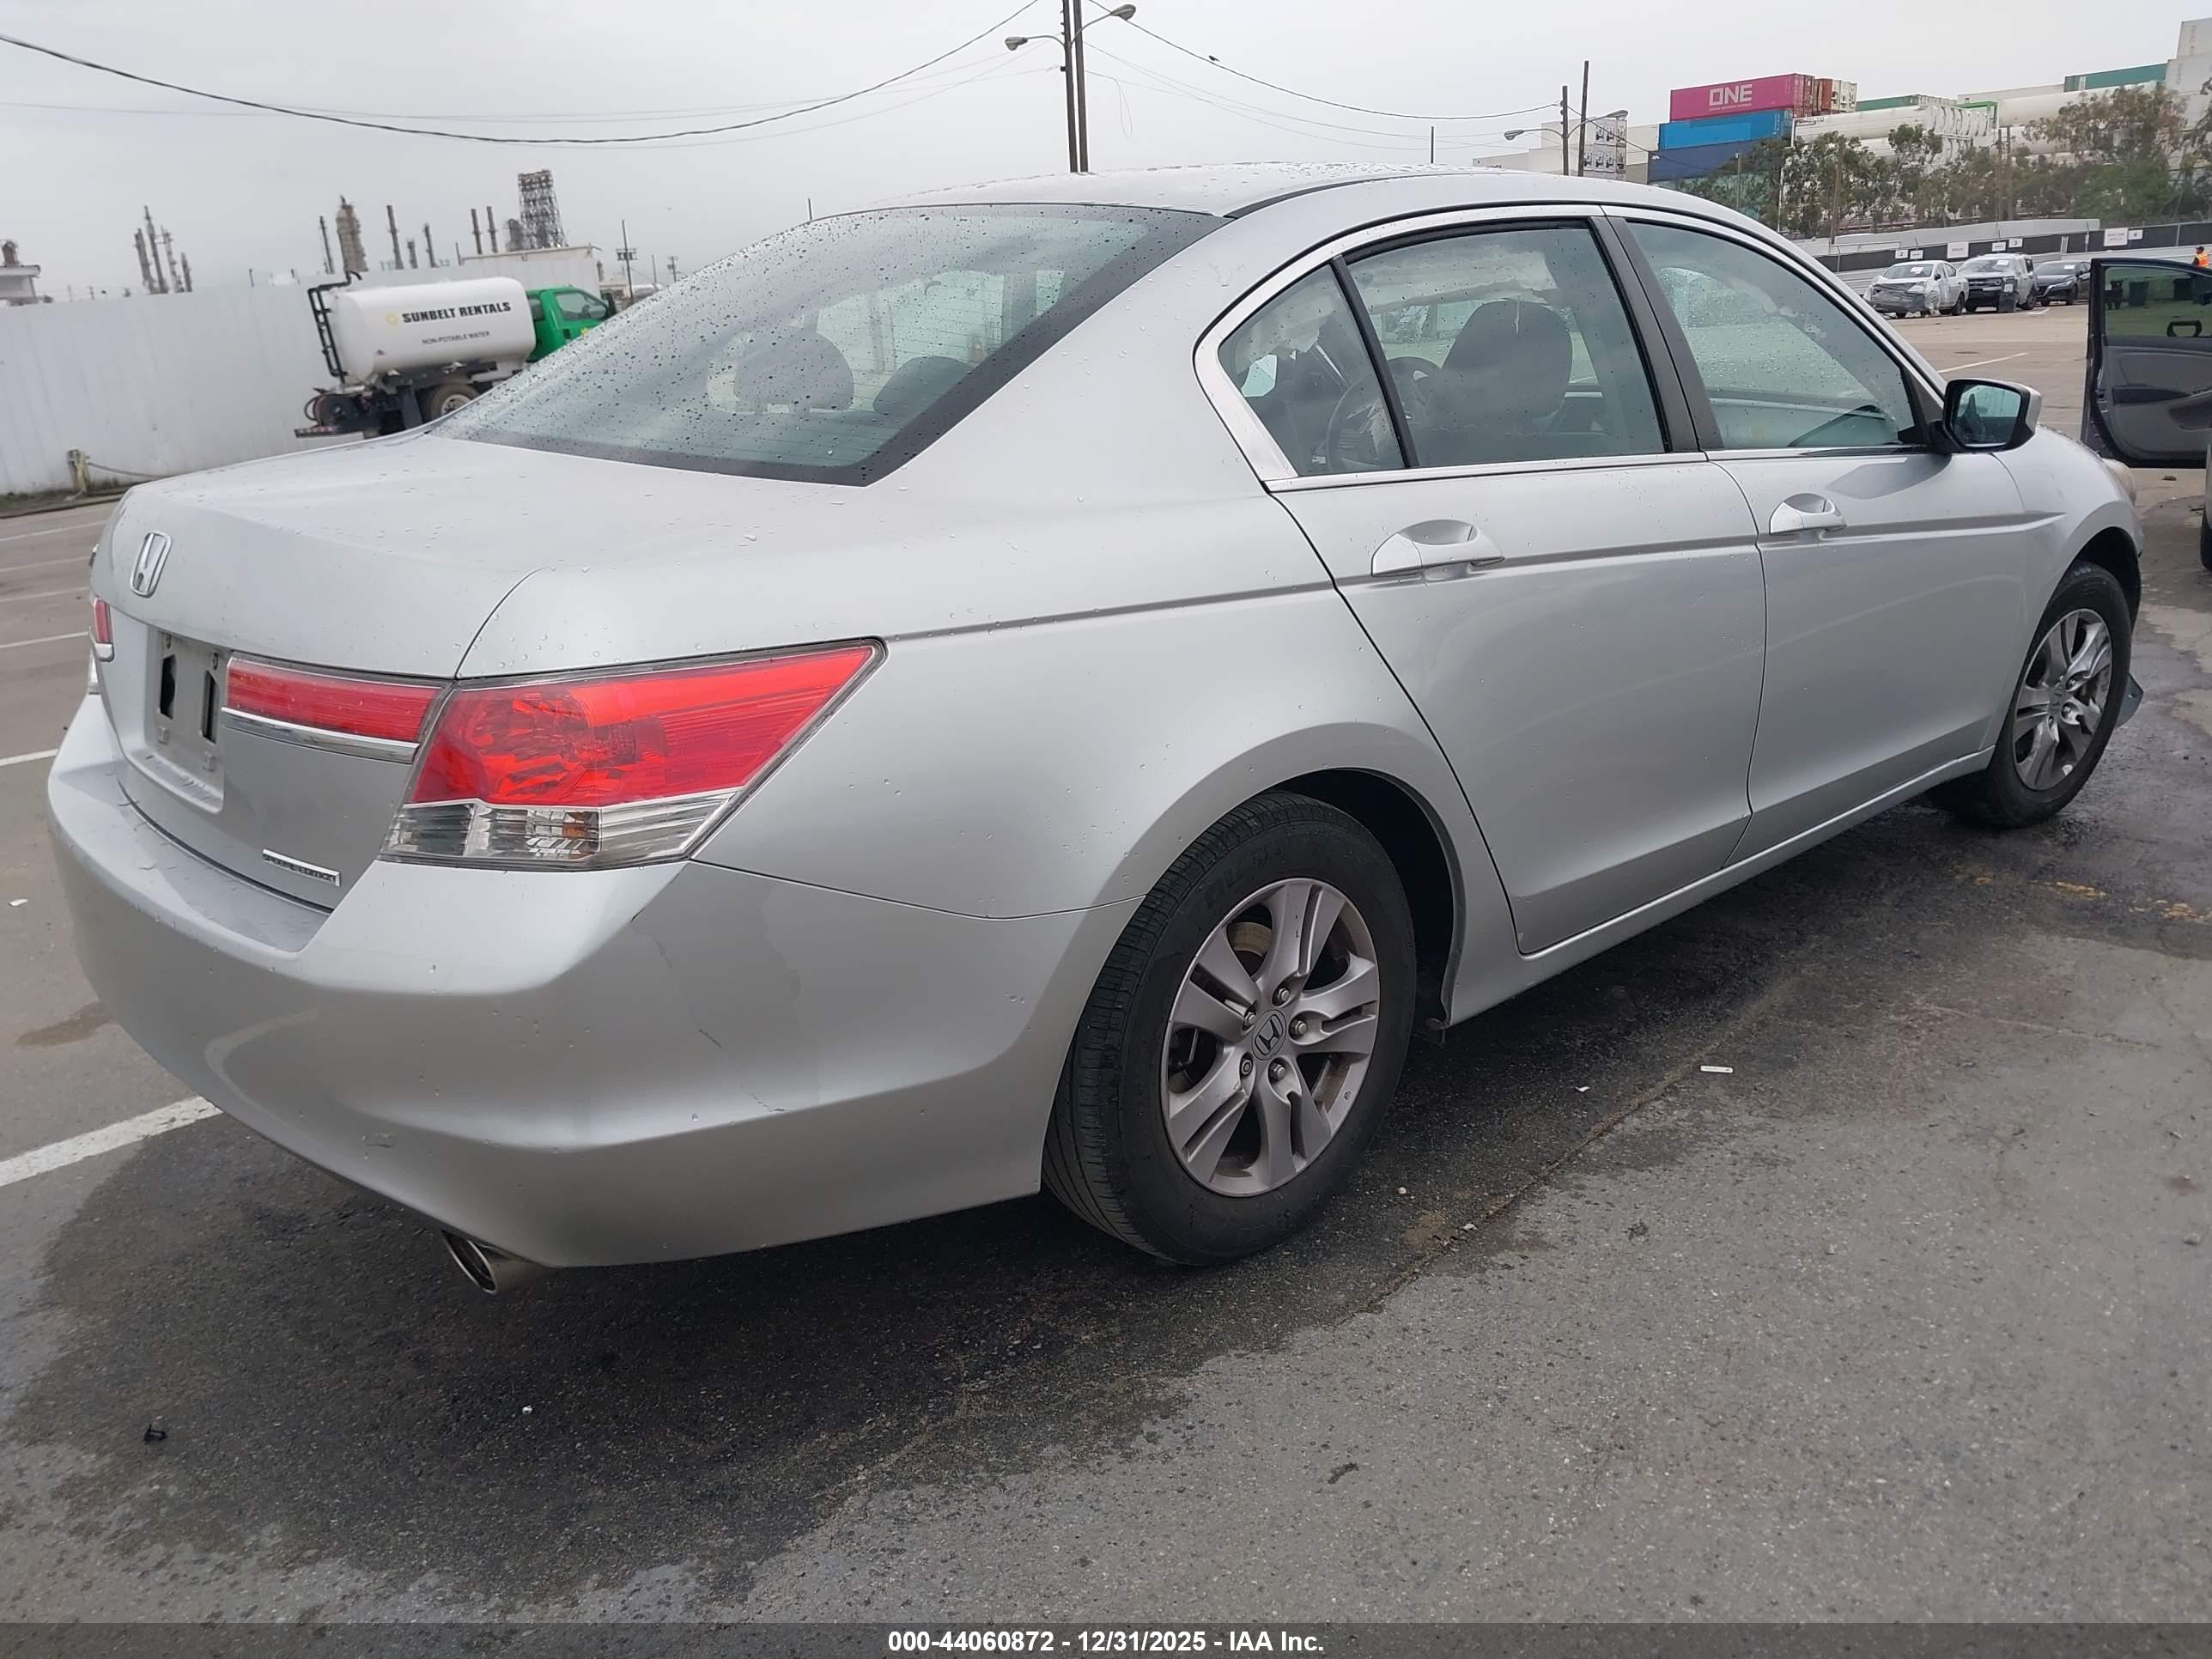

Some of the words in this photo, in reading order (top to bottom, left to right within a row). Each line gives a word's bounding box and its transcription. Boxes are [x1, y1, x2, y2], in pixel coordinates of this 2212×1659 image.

[1709, 84, 1753, 106] ONE
[402, 307, 456, 323] SUNBELT
[459, 301, 511, 316] RENTALS
